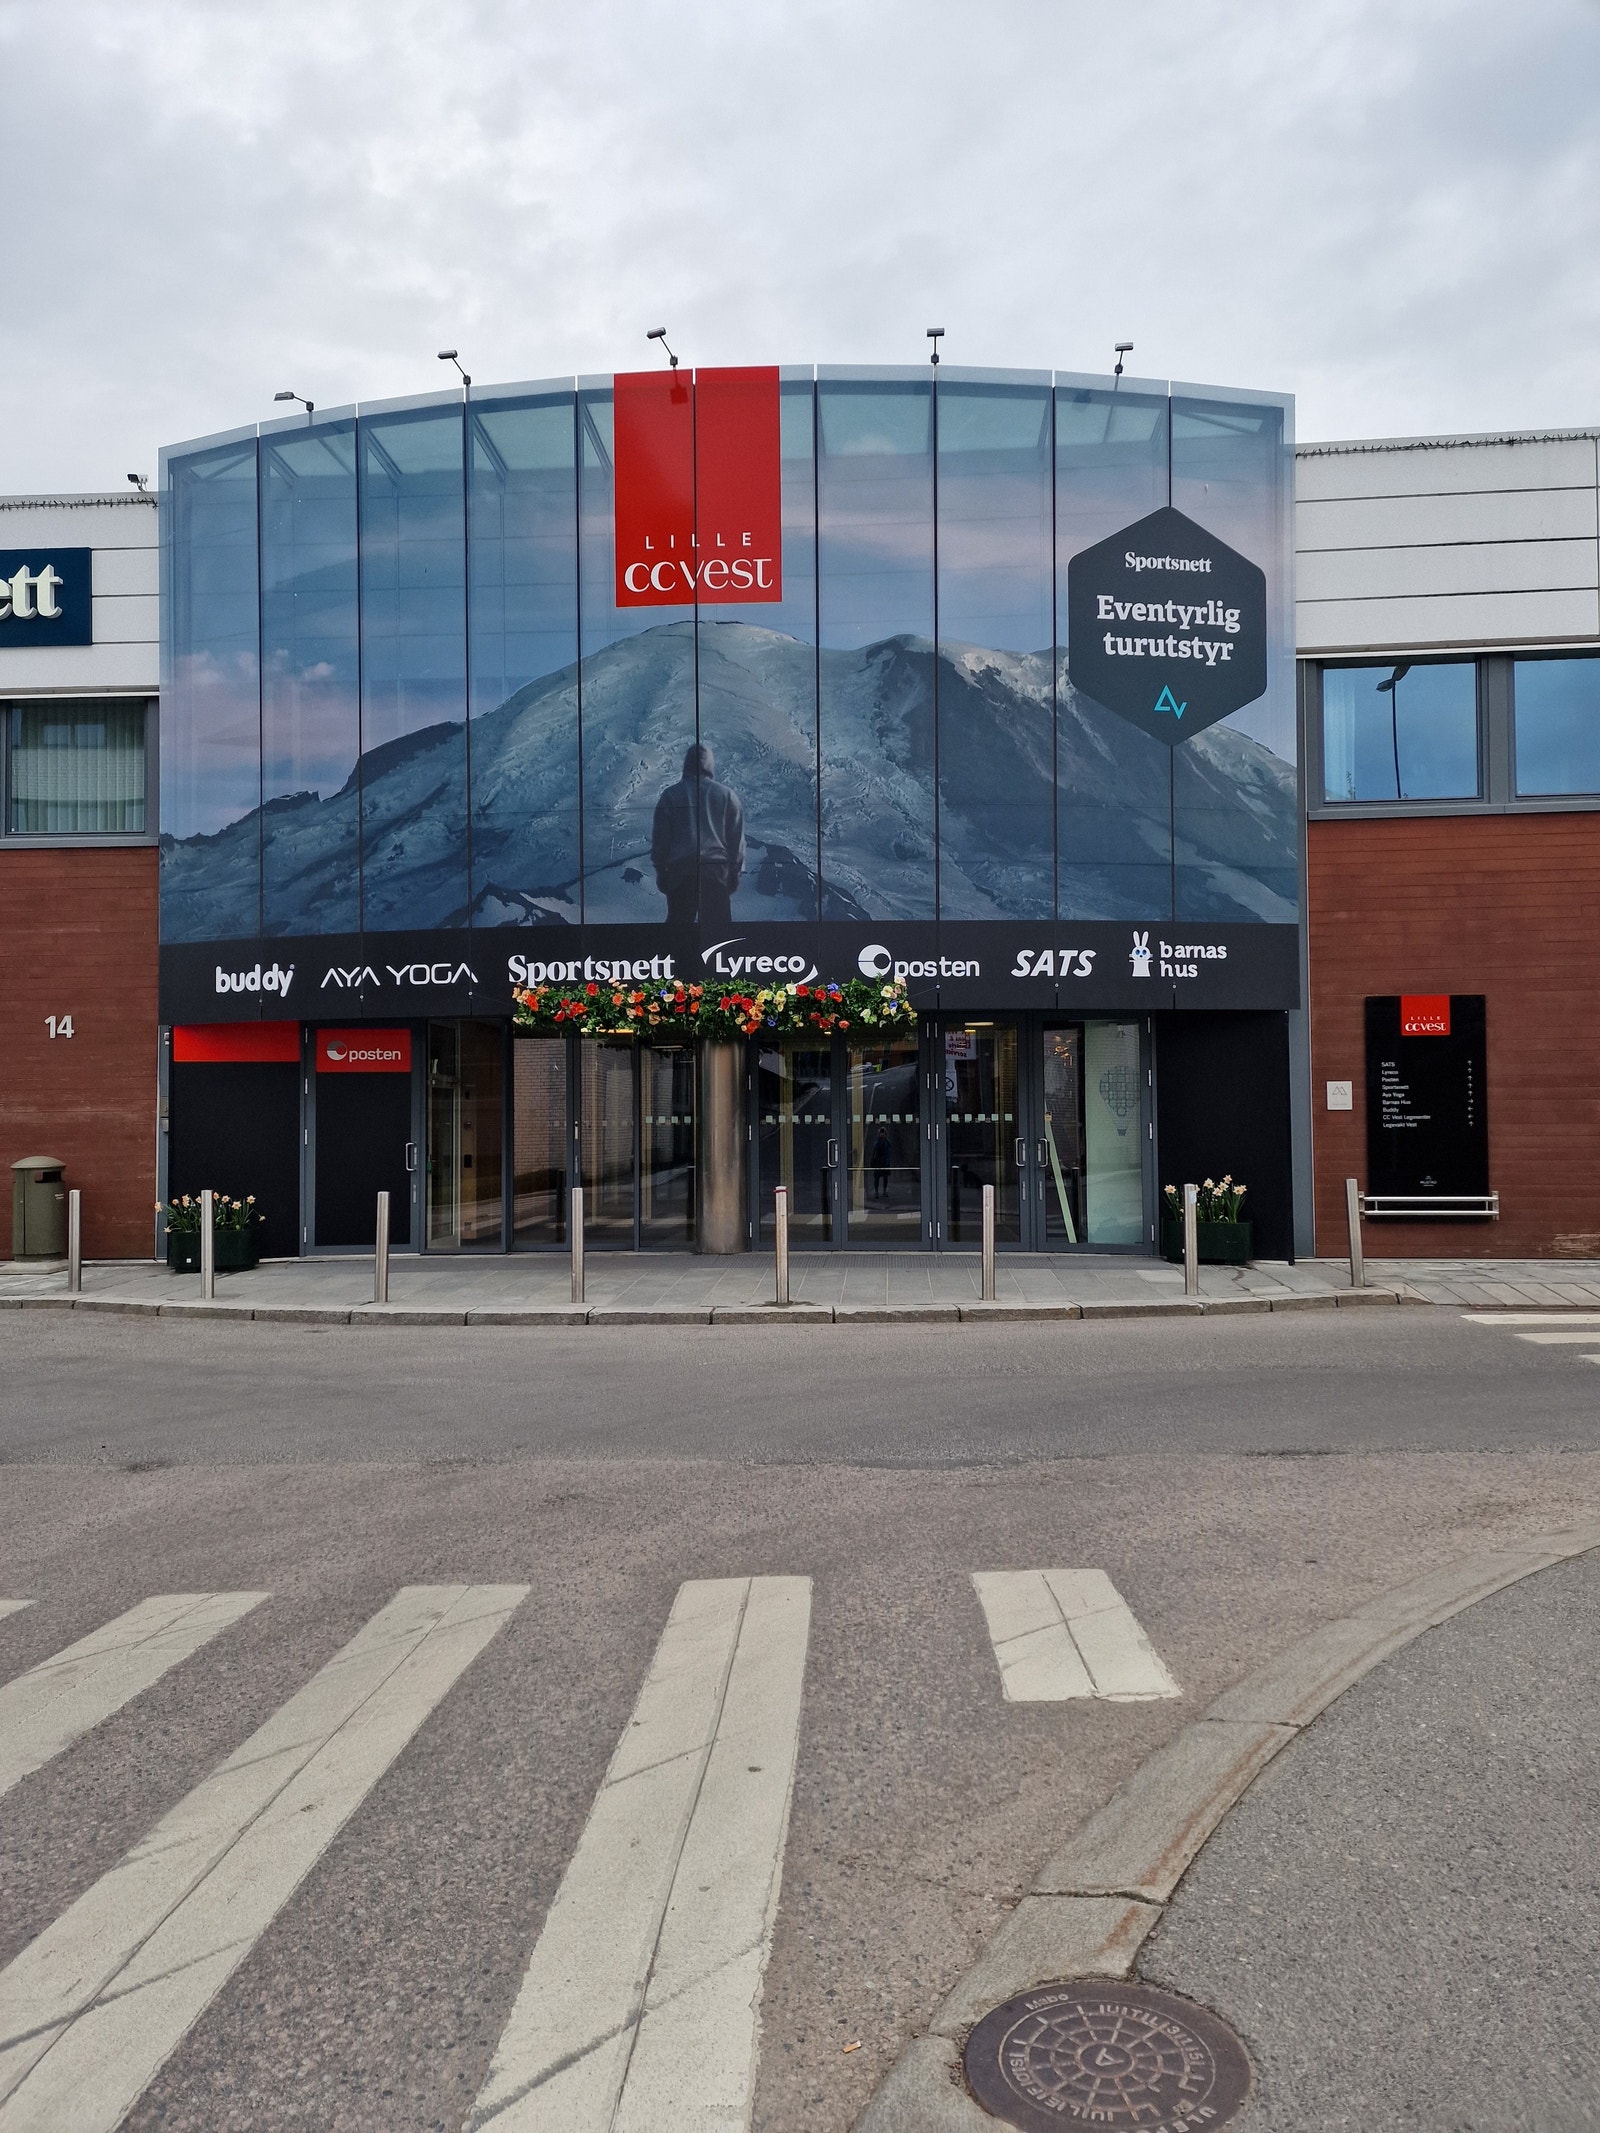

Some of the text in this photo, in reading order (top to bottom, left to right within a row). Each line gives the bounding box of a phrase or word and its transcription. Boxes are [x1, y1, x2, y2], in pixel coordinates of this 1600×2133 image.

[645, 532, 752, 549] LILLE
[1125, 552, 1212, 573] Sportsnett
[1097, 595, 1241, 634] Eventyrlig
[1103, 632, 1234, 666] turutstyr
[1159, 940, 1228, 960] barnas
[507, 954, 676, 988] Sportsnett
[714, 949, 806, 976] Lyreco
[893, 956, 980, 980] posten
[1011, 949, 1097, 978] SATS
[1159, 960, 1200, 979] hus
[215, 963, 295, 997] buddy
[320, 963, 479, 989] AYA YOGA
[44, 1015, 75, 1039] 14
[348, 1047, 402, 1063] posten
[1025, 1993, 1069, 2010] Mabo
